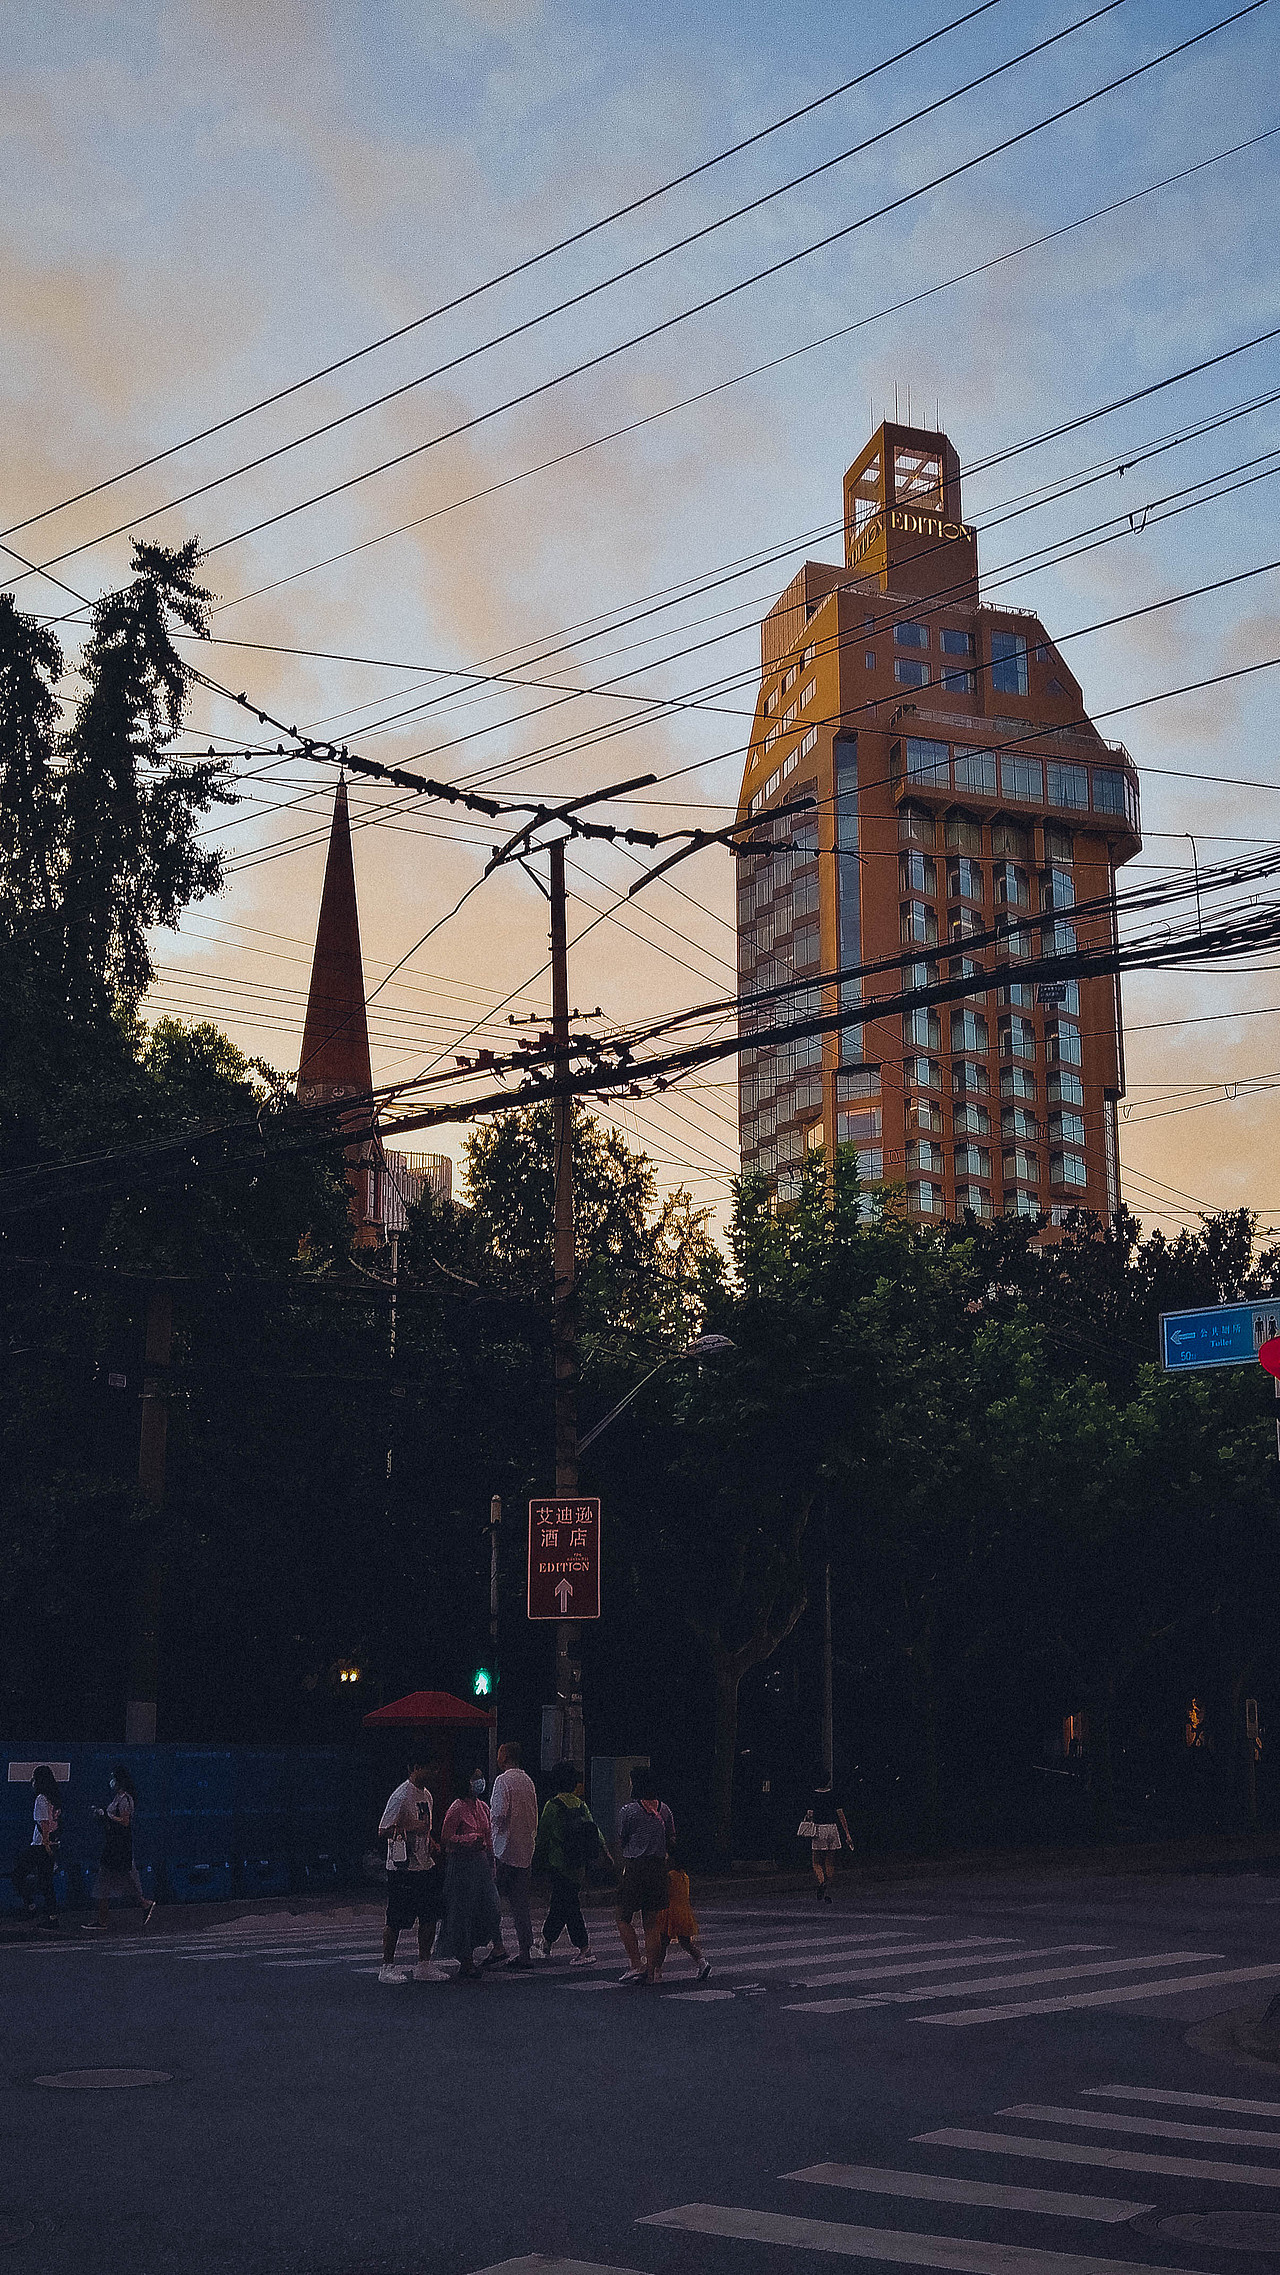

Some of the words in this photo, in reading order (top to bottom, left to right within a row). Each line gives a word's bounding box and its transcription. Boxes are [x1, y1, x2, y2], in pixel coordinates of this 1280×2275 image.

[890, 512, 972, 543] EDITION
[1210, 1338, 1232, 1348] Toilet
[536, 1507, 593, 1526] 艾迪逊
[541, 1528, 587, 1547] 酒店
[539, 1562, 590, 1573] EDITION
